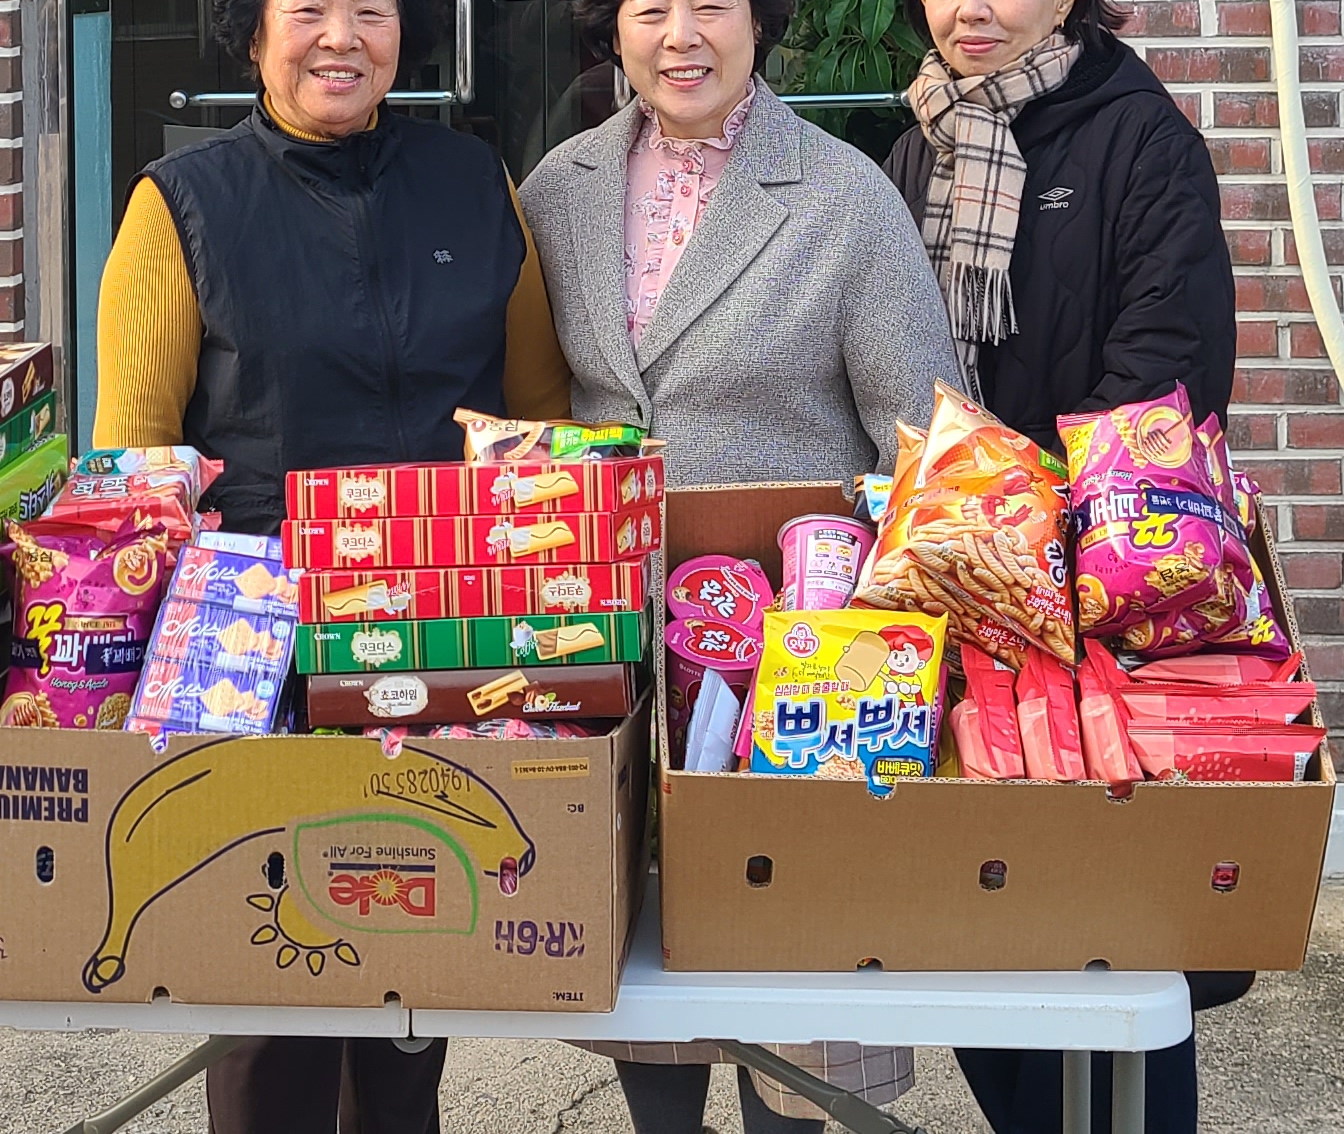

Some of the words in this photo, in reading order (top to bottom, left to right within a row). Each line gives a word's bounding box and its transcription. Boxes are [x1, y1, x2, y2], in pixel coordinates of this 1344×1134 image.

[1039, 201, 1069, 211] umbro
[304, 478, 329, 486] CROWN
[346, 486, 380, 499] 쿠크다스
[341, 536, 375, 549] 쿠크다스
[179, 560, 240, 585] 에이스
[548, 585, 584, 598] 쿠크다스
[160, 616, 221, 642] 에이스
[314, 632, 341, 640] CROWN
[358, 642, 395, 654] 쿠크다스
[144, 675, 207, 699] 에이스
[380, 689, 418, 701] 초코하임
[350, 847, 372, 859] For
[376, 847, 436, 860] Sunshine
[328, 870, 436, 917] Dole
[552, 992, 584, 1002] ITEM:
